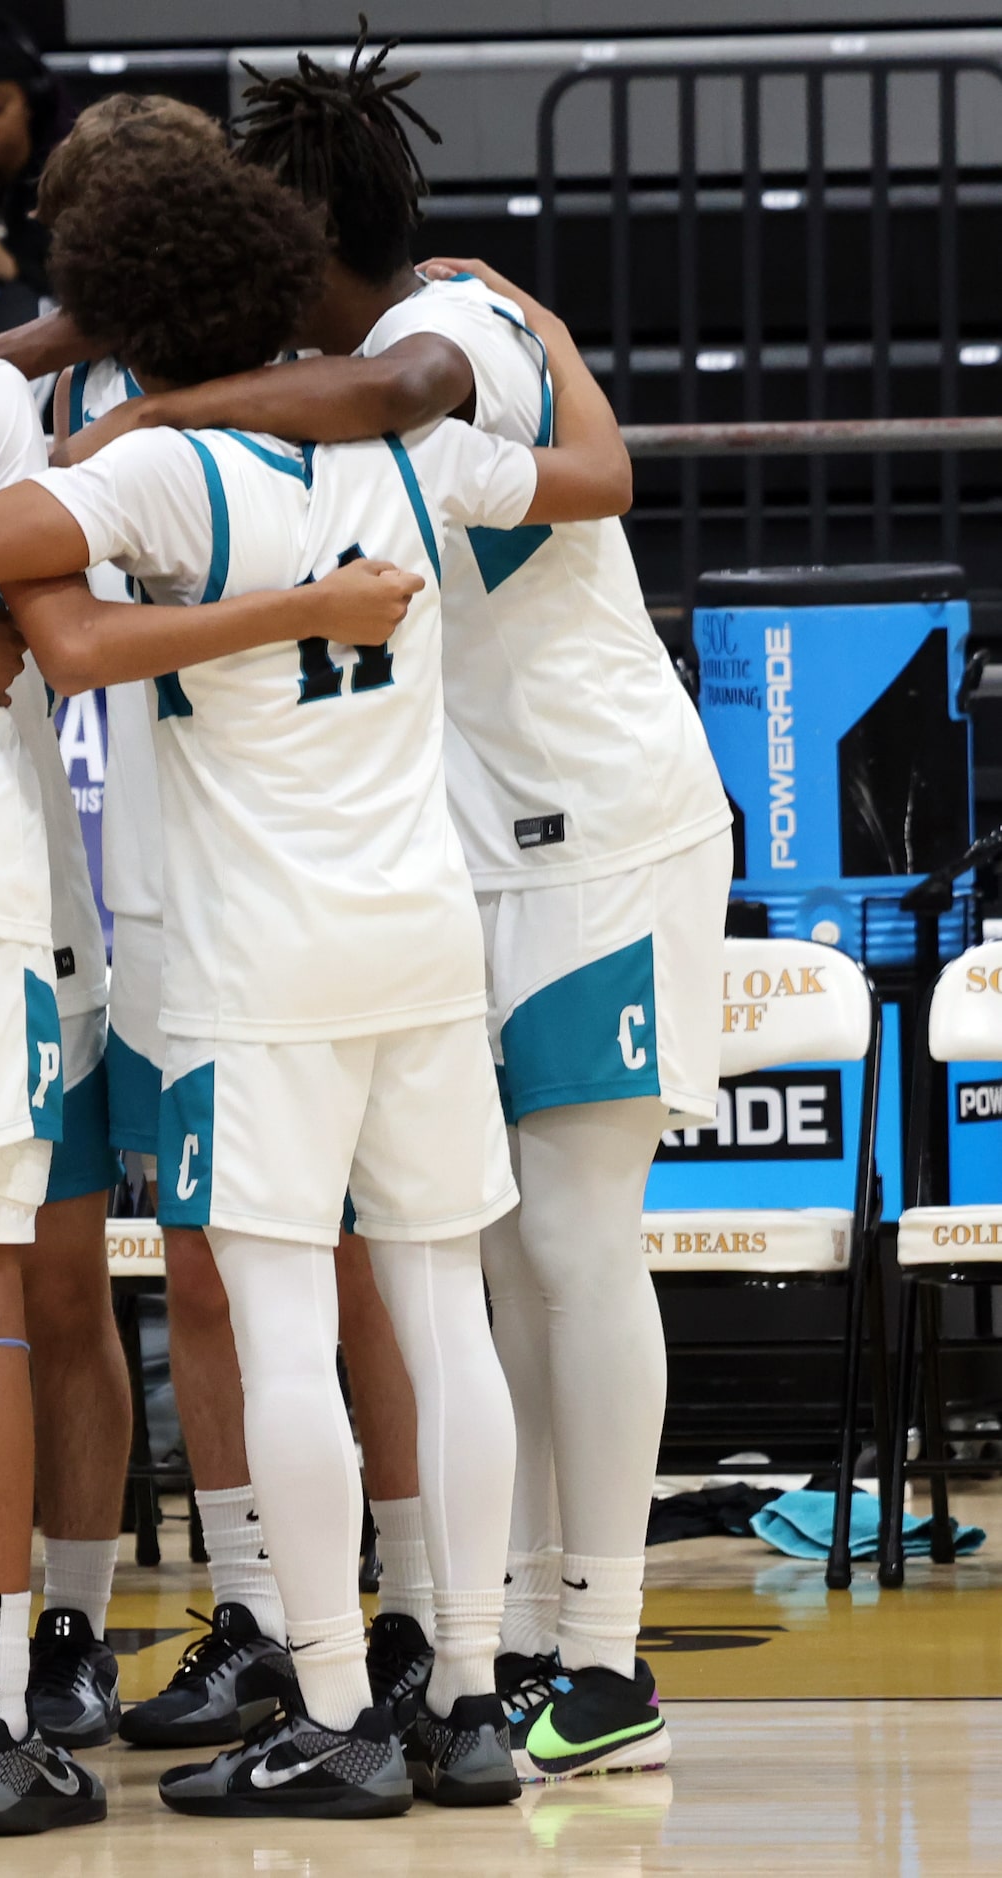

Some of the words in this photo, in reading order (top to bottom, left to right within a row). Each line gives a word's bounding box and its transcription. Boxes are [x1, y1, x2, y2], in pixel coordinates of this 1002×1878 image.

[765, 626, 797, 869] POWERADE
[742, 966, 827, 999] OAK
[617, 1004, 646, 1071] C
[32, 1041, 60, 1108] P
[176, 1133, 199, 1200] C
[673, 1231, 767, 1254] BEARS
